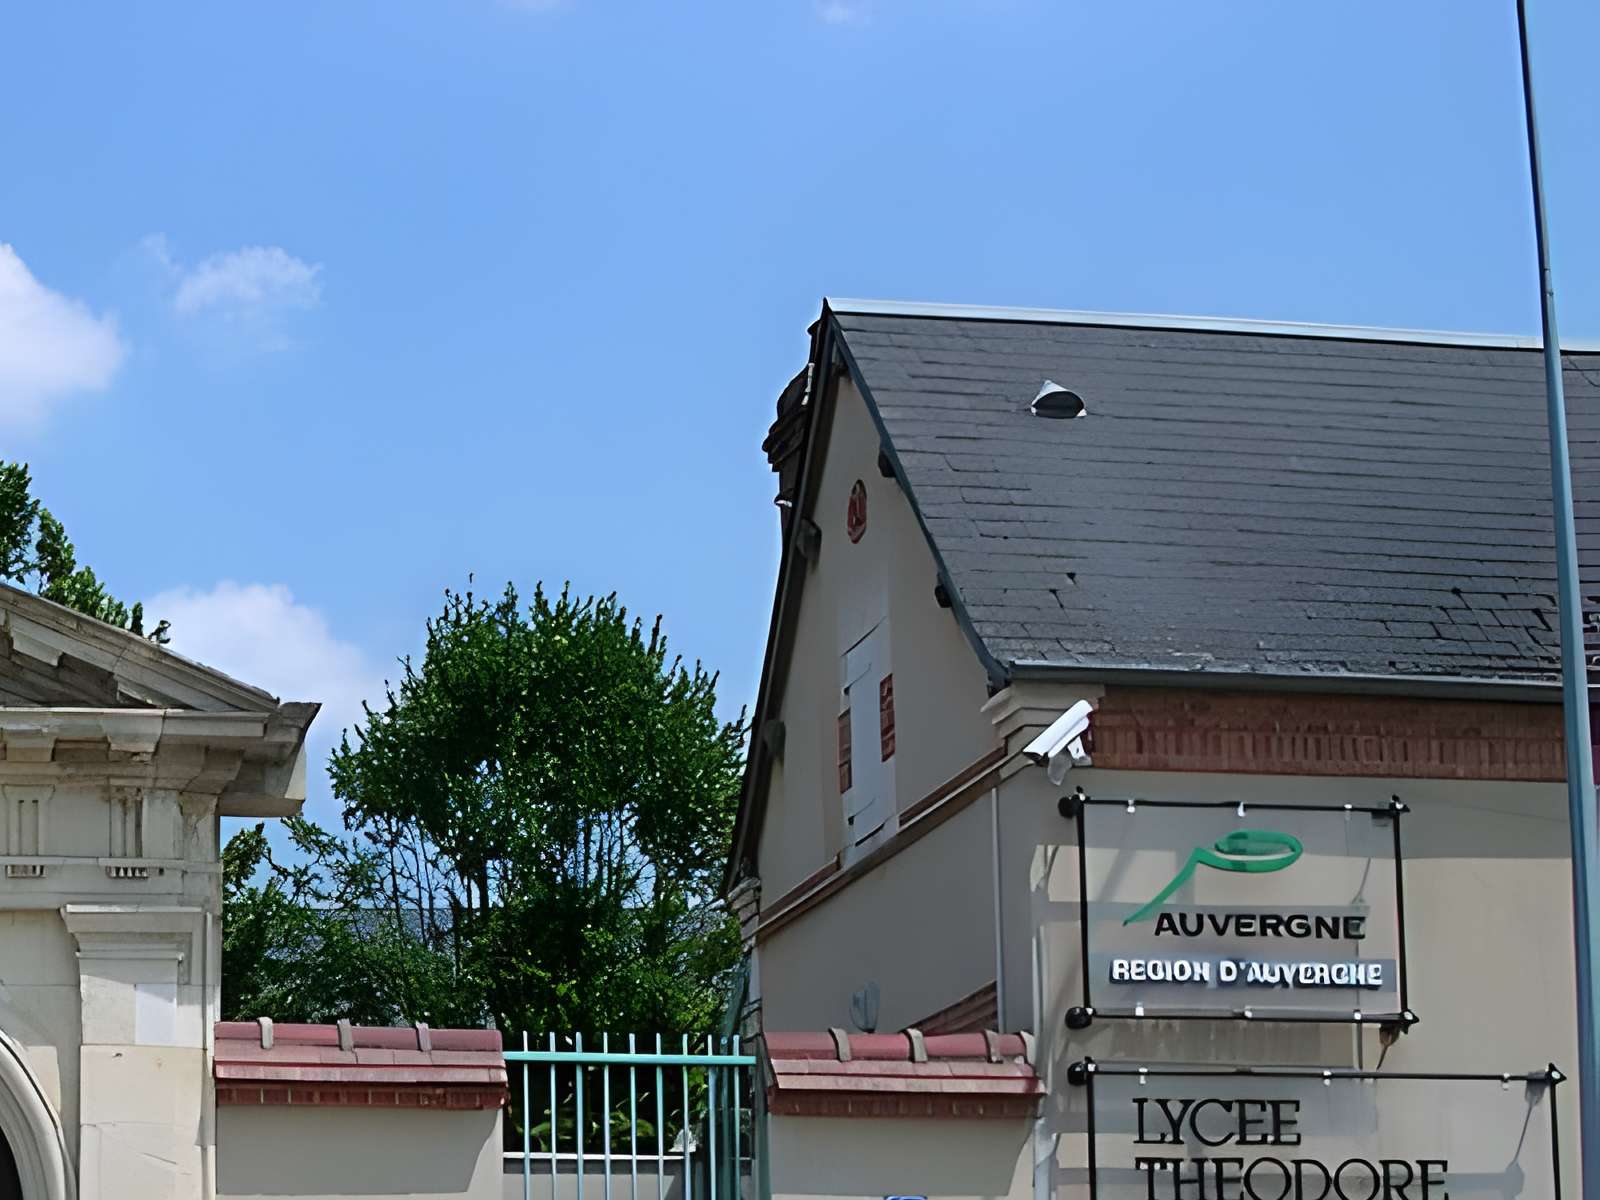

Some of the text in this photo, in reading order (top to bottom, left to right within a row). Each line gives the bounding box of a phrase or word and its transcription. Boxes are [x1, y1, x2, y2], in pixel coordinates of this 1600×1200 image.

[1154, 912, 1367, 940] AUVERGNE
[1111, 959, 1211, 982] REGION
[1132, 1098, 1301, 1146] LYCEE
